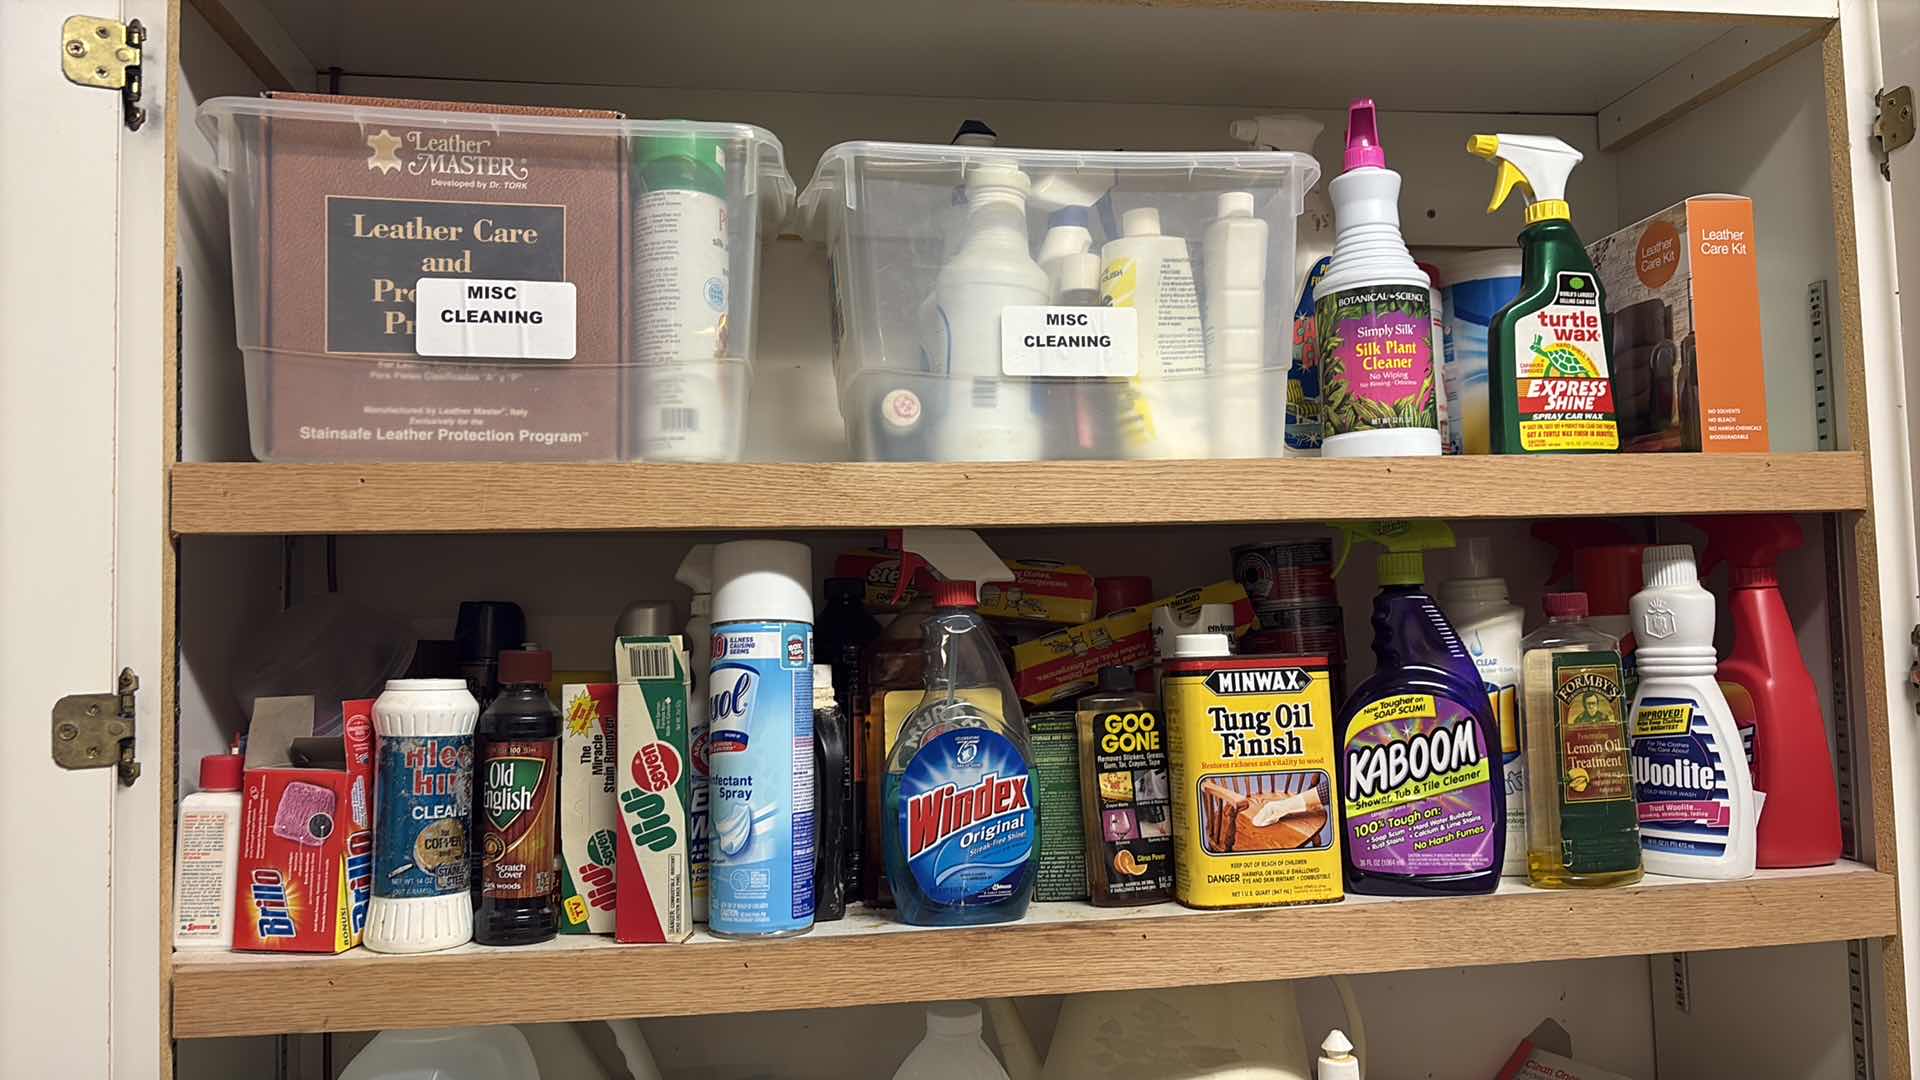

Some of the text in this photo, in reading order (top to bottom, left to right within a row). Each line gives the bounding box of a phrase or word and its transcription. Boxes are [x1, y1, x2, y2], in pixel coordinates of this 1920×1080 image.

[406, 131, 490, 153] Leather
[408, 154, 529, 180] MASTER
[431, 178, 528, 190] Developed by Dr. TORK
[352, 213, 538, 245] Leather Care
[1702, 229, 1744, 241] Leather
[1642, 238, 1673, 258] Leather
[1700, 243, 1747, 255] Care Kit
[421, 250, 473, 273] and
[1640, 251, 1675, 272] Care Kit
[467, 286, 518, 300] MISC
[1339, 292, 1425, 307] BOTANICAL SCIENCE
[441, 309, 544, 325] CLEANING
[1046, 313, 1088, 326] MISC
[1537, 311, 1598, 328] turtle
[1357, 325, 1414, 338] Simply Silk
[1554, 328, 1598, 342] wax
[1024, 335, 1111, 348] CLEANING
[1355, 340, 1416, 357] Silk Plant
[1363, 356, 1412, 370] Cleaner
[1384, 372, 1409, 381] Wiping
[1527, 380, 1607, 398] EXPRESS
[1544, 396, 1595, 411] SHINE
[1533, 413, 1564, 421] SPRAY
[300, 426, 372, 441] Stainsafe
[376, 427, 434, 442] Leather
[438, 428, 514, 443] Protection
[1218, 670, 1300, 693] MINWAX
[1558, 673, 1617, 700] FORMBY'S
[1363, 704, 1379, 715] Now
[1380, 697, 1414, 710] Tougher
[1374, 703, 1426, 720] SOAP SCUM!
[1639, 707, 1684, 721] IMPROVED!
[1104, 712, 1155, 734] GOO
[1208, 703, 1314, 736] Tung Oil
[1101, 731, 1160, 753] GONE
[1221, 731, 1303, 758] Finish
[1566, 738, 1621, 755] Lemon Oil
[580, 745, 592, 764] The
[591, 734, 604, 776] Miracle
[603, 717, 616, 793] Stain Remover
[956, 740, 981, 764] 75
[1097, 755, 1122, 763] Removes
[1349, 719, 1477, 800] KABOOM
[640, 742, 670, 792] seven
[1149, 759, 1161, 767] Tape
[1201, 761, 1230, 769] Restores
[1272, 759, 1297, 767] vitality
[1306, 757, 1325, 765] wood
[1568, 755, 1622, 769] Treatment
[489, 761, 514, 790] Old
[1632, 755, 1714, 790] Woolite
[719, 787, 753, 801] Spray
[1355, 770, 1482, 811] Shower, Tub & Tile Cleaner
[1678, 791, 1697, 799] WASH
[484, 783, 531, 817] English
[1648, 804, 1665, 812] Trust
[908, 776, 1030, 860] Windex
[1354, 818, 1385, 838] 100%
[1388, 811, 1421, 828] Tough
[1423, 806, 1442, 819] on:
[1413, 809, 1473, 831] Hard Water Buildup
[959, 814, 1025, 849] Original
[1371, 829, 1405, 843] Soap Scum
[1414, 827, 1440, 838] Calcium
[1414, 825, 1485, 851] No Harsh Fumes
[594, 829, 617, 867] seven
[1386, 836, 1405, 846] Stains
[495, 863, 526, 873] Scratch
[498, 870, 523, 880] Cover
[496, 882, 521, 890] woods
[1207, 873, 1241, 885] DANGER
[250, 868, 297, 940] Brillo
[572, 901, 584, 918] TV
[341, 908, 350, 946] BONUS!
